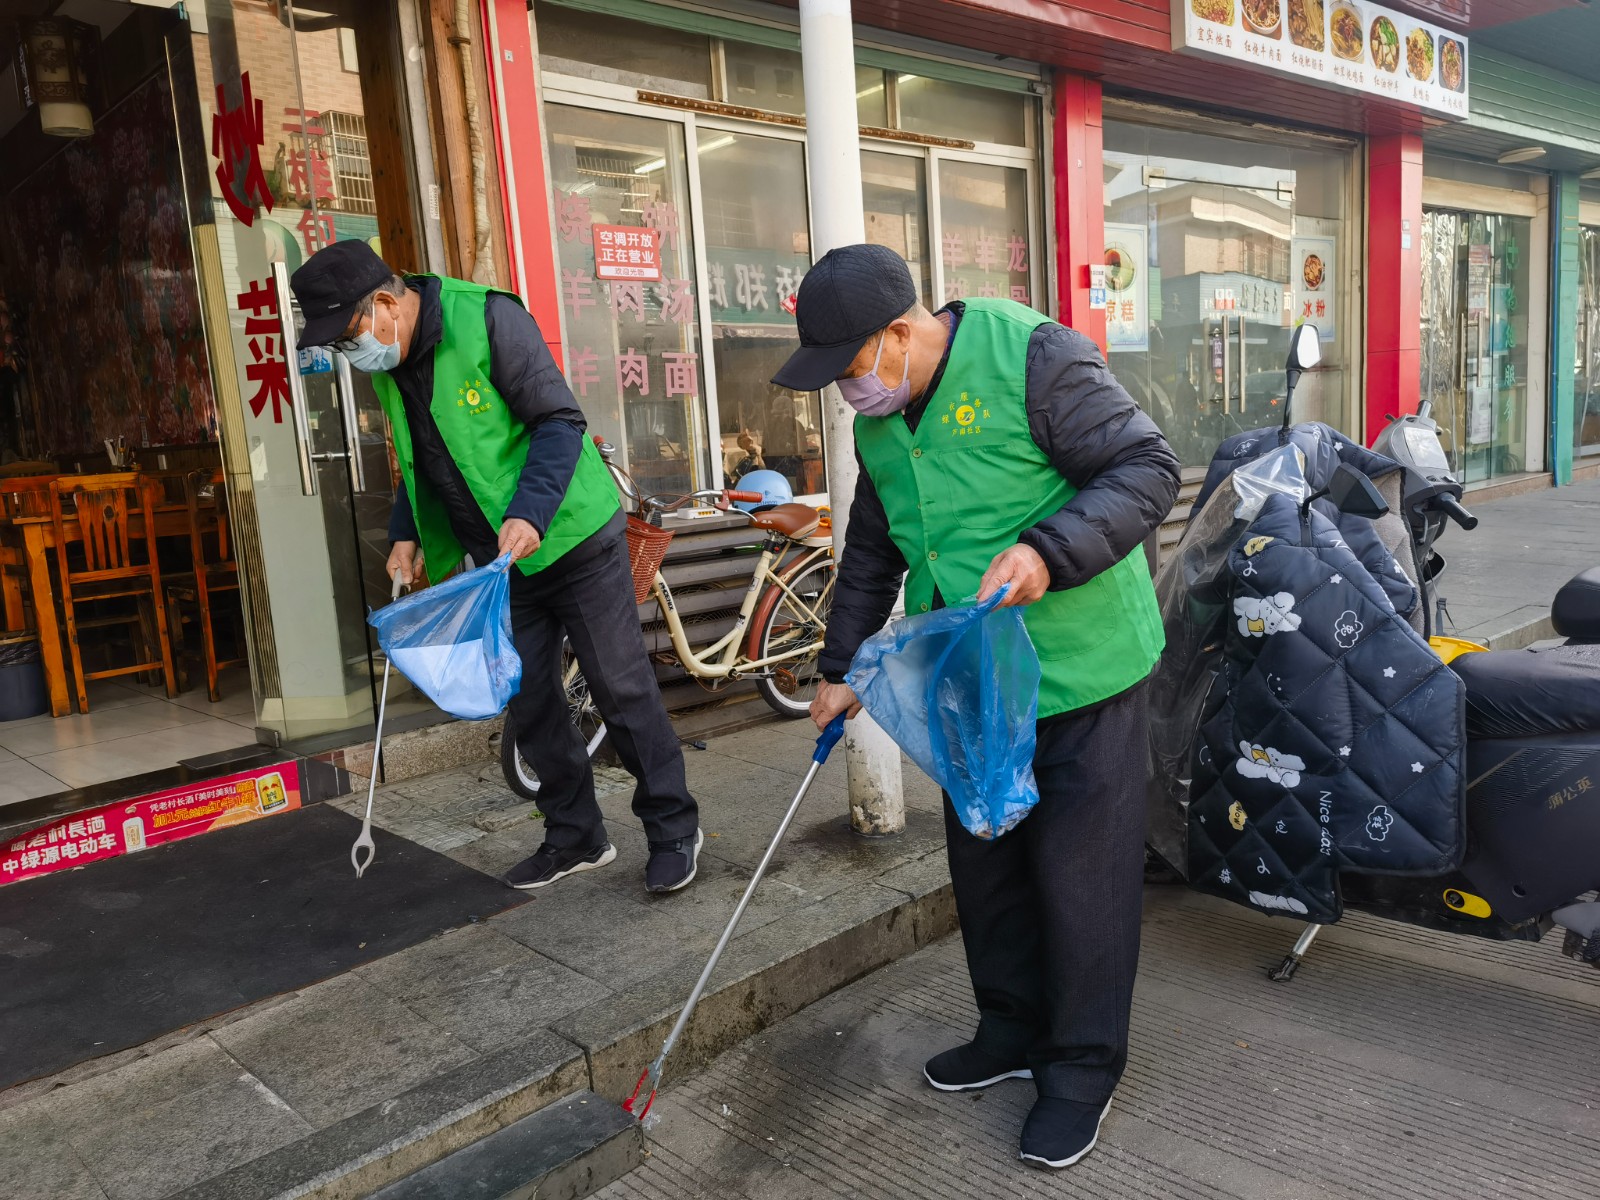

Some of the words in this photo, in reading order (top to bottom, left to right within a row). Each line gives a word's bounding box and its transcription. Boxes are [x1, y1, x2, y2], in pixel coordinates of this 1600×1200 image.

[1244, 40, 1281, 62] 红烧牛肉面
[600, 231, 654, 248] 空调开放
[601, 248, 655, 264] 正在营业
[561, 268, 695, 324] 羊肉汤
[1303, 299, 1325, 318] 冰粉
[568, 347, 699, 398] 羊肉面
[1319, 790, 1332, 823] Nice
[2, 833, 117, 874] 中绿源电动车
